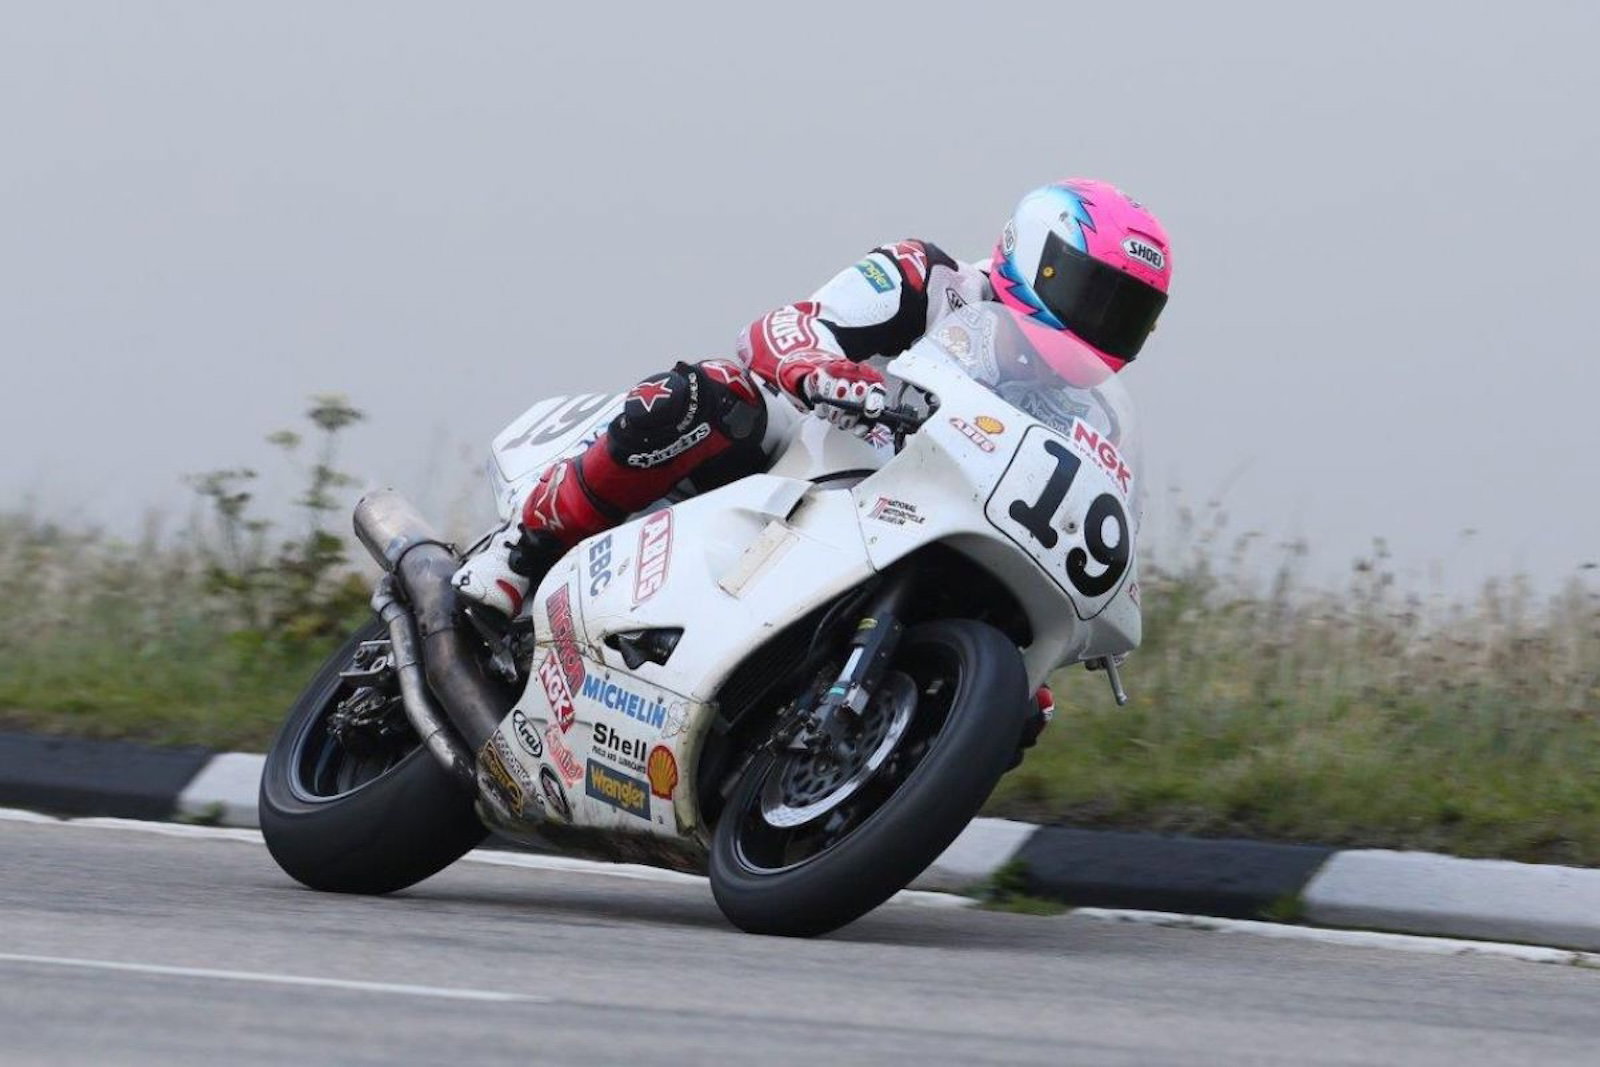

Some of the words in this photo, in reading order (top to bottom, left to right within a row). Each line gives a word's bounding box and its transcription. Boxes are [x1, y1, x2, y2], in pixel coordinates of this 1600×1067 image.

[1129, 241, 1163, 267] SHOEI
[1074, 421, 1131, 494] NGK
[1009, 439, 1131, 598] 19
[589, 533, 613, 597] EBC
[540, 661, 572, 723] NGK
[583, 674, 667, 729] MICHELIN
[514, 719, 541, 753] Arai
[593, 722, 647, 761] Shell
[591, 764, 646, 810] Wrangler
